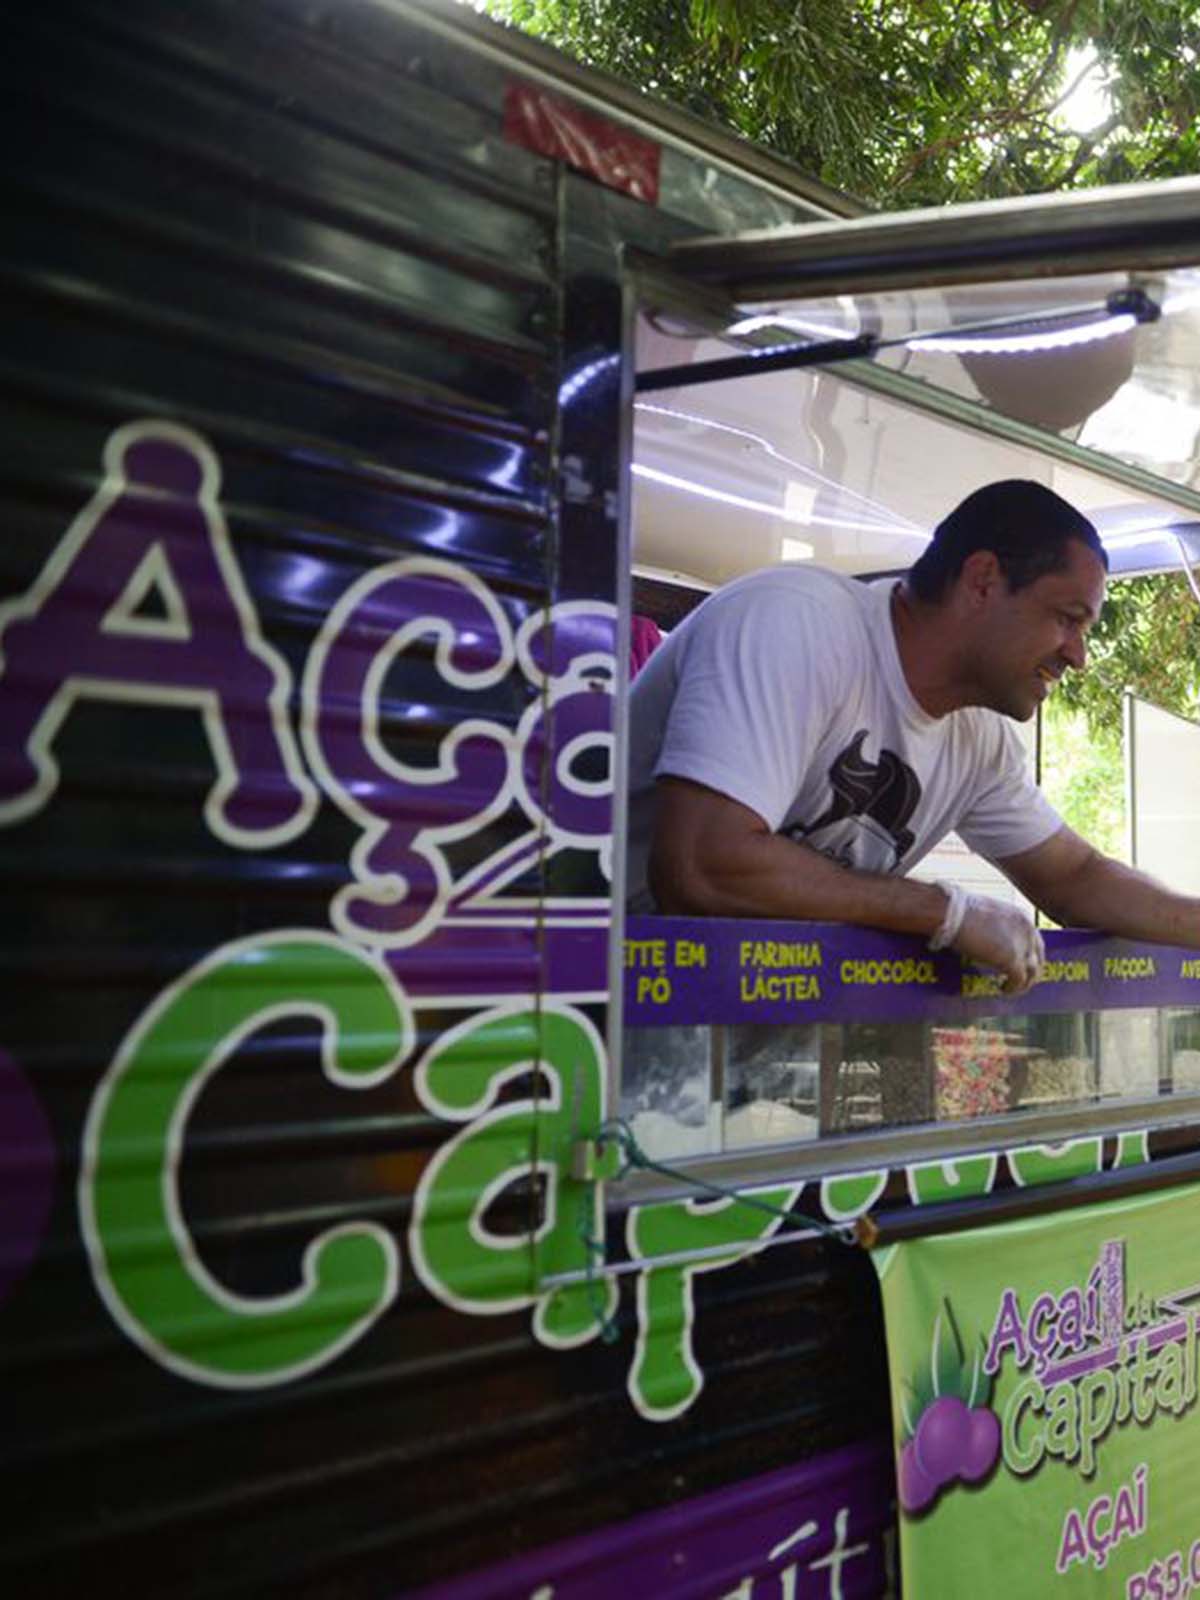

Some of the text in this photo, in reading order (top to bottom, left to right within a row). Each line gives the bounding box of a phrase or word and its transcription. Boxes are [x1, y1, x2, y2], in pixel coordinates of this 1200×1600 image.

[675, 940, 706, 968] EM
[739, 940, 822, 968] FARINHA
[840, 959, 938, 985] CHOCOBOL
[637, 967, 671, 1004] PÓ
[740, 966, 821, 1002] LÁCTEA
[984, 1262, 1101, 1376] Açaí
[1002, 1311, 1199, 1476] Capital
[1056, 1463, 1149, 1572] AÇAÍ
